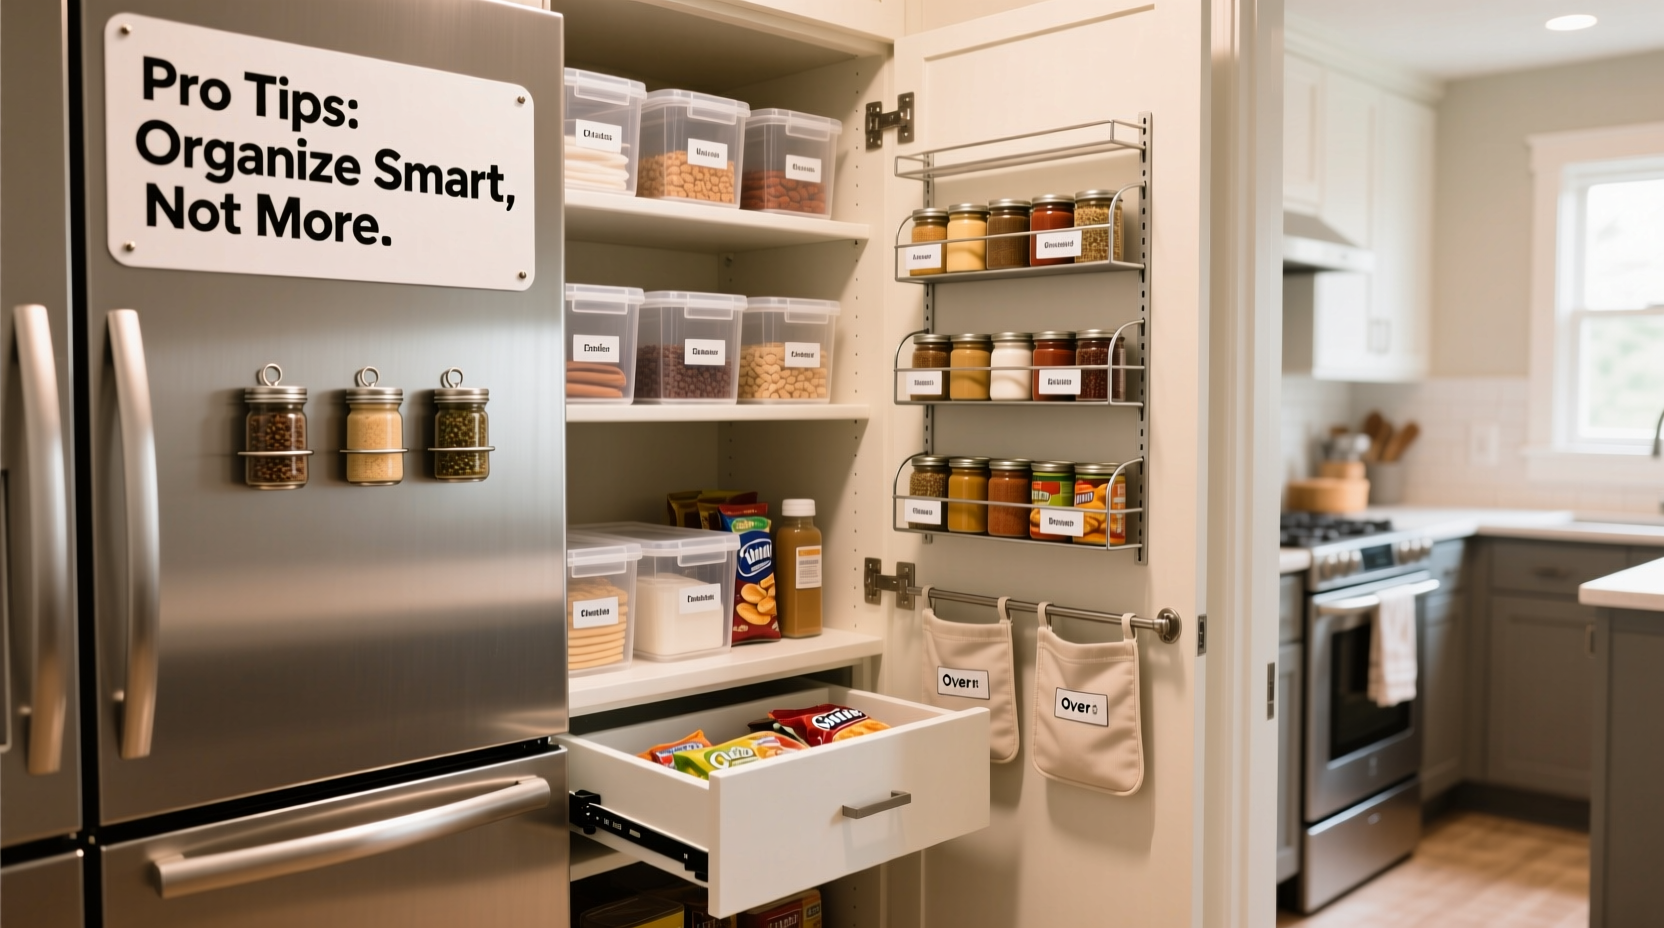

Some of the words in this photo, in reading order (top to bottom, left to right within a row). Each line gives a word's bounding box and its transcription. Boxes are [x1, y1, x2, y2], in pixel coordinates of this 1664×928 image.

[143, 55, 232, 111] Pro
[244, 71, 359, 132] Tips:
[135, 119, 361, 184] Organize
[374, 148, 515, 211] Smart,
[146, 183, 242, 235] Not
[257, 193, 392, 247] More.
